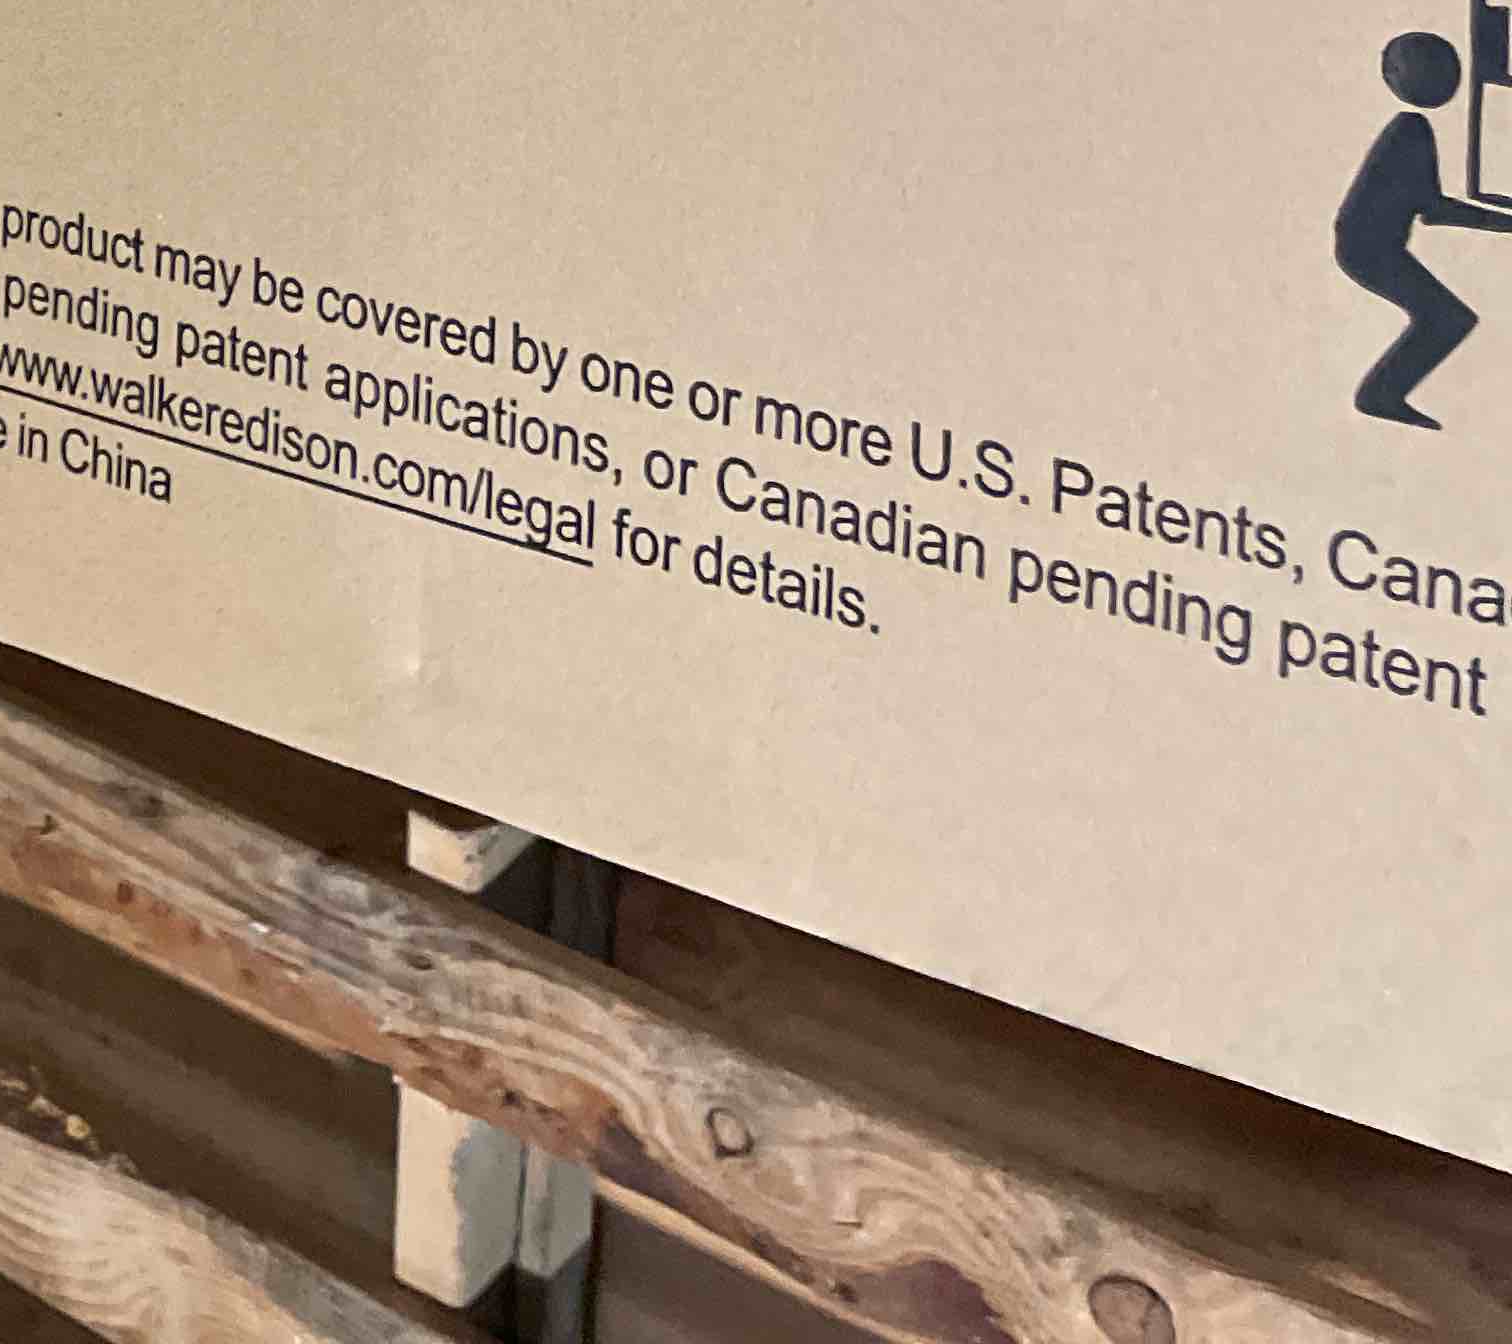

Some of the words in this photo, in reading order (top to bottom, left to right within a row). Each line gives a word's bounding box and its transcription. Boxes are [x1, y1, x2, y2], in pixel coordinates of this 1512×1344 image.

[2, 205, 144, 273] product
[156, 244, 241, 307] may
[254, 257, 304, 313] be
[317, 287, 496, 364] covered
[513, 322, 568, 393] by
[581, 353, 673, 409] one
[689, 382, 742, 425] or
[756, 396, 892, 466] more
[909, 421, 1030, 507] U.S.
[1053, 458, 1302, 584] Patents,
[1329, 530, 1512, 626] Cana
[4, 275, 158, 359] pending
[177, 322, 307, 390] patent
[326, 358, 621, 486] applications,
[645, 450, 698, 495] or
[717, 457, 984, 578] Canadian
[1010, 548, 1251, 665] pending
[1280, 621, 1486, 716] patent
[19, 413, 47, 462] in
[61, 429, 171, 504] China
[613, 509, 681, 571] for
[694, 536, 879, 634] details.
